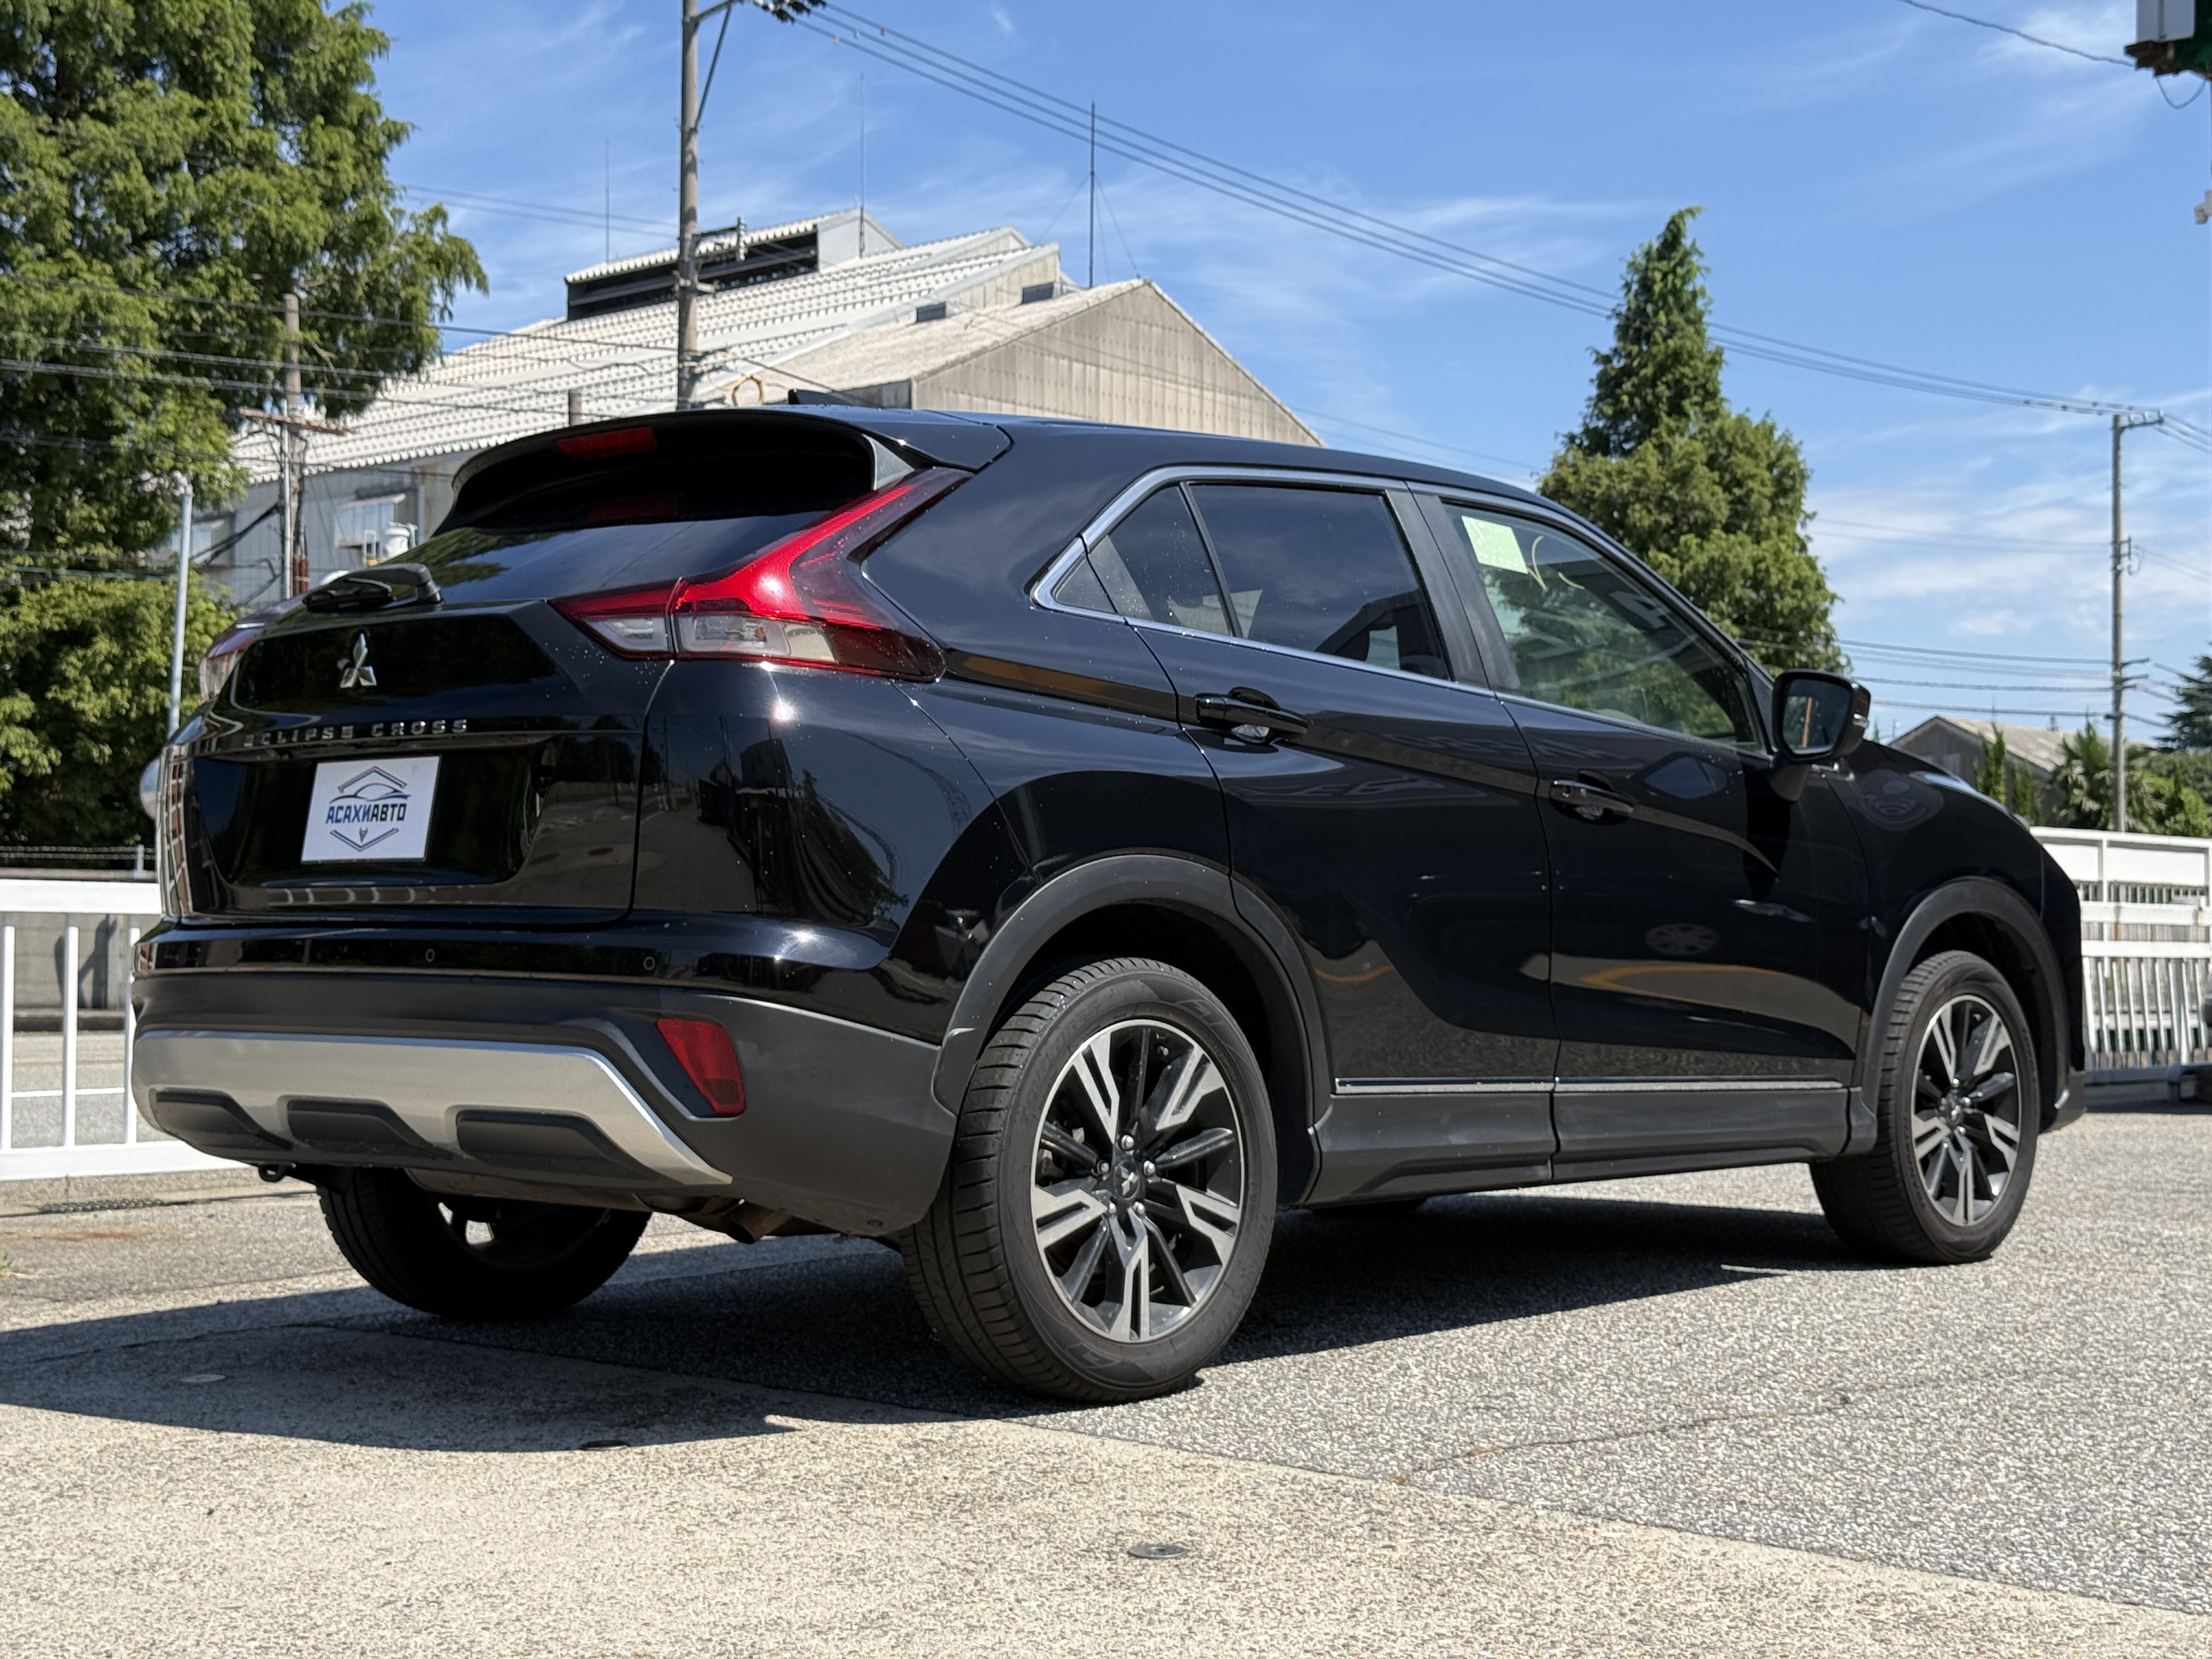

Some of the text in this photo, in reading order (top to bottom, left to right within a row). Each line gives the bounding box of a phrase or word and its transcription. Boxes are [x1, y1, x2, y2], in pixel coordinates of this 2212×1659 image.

[244, 719, 467, 747] ECLIPSE CROSS
[325, 803, 407, 824] АСАХИАВТО
